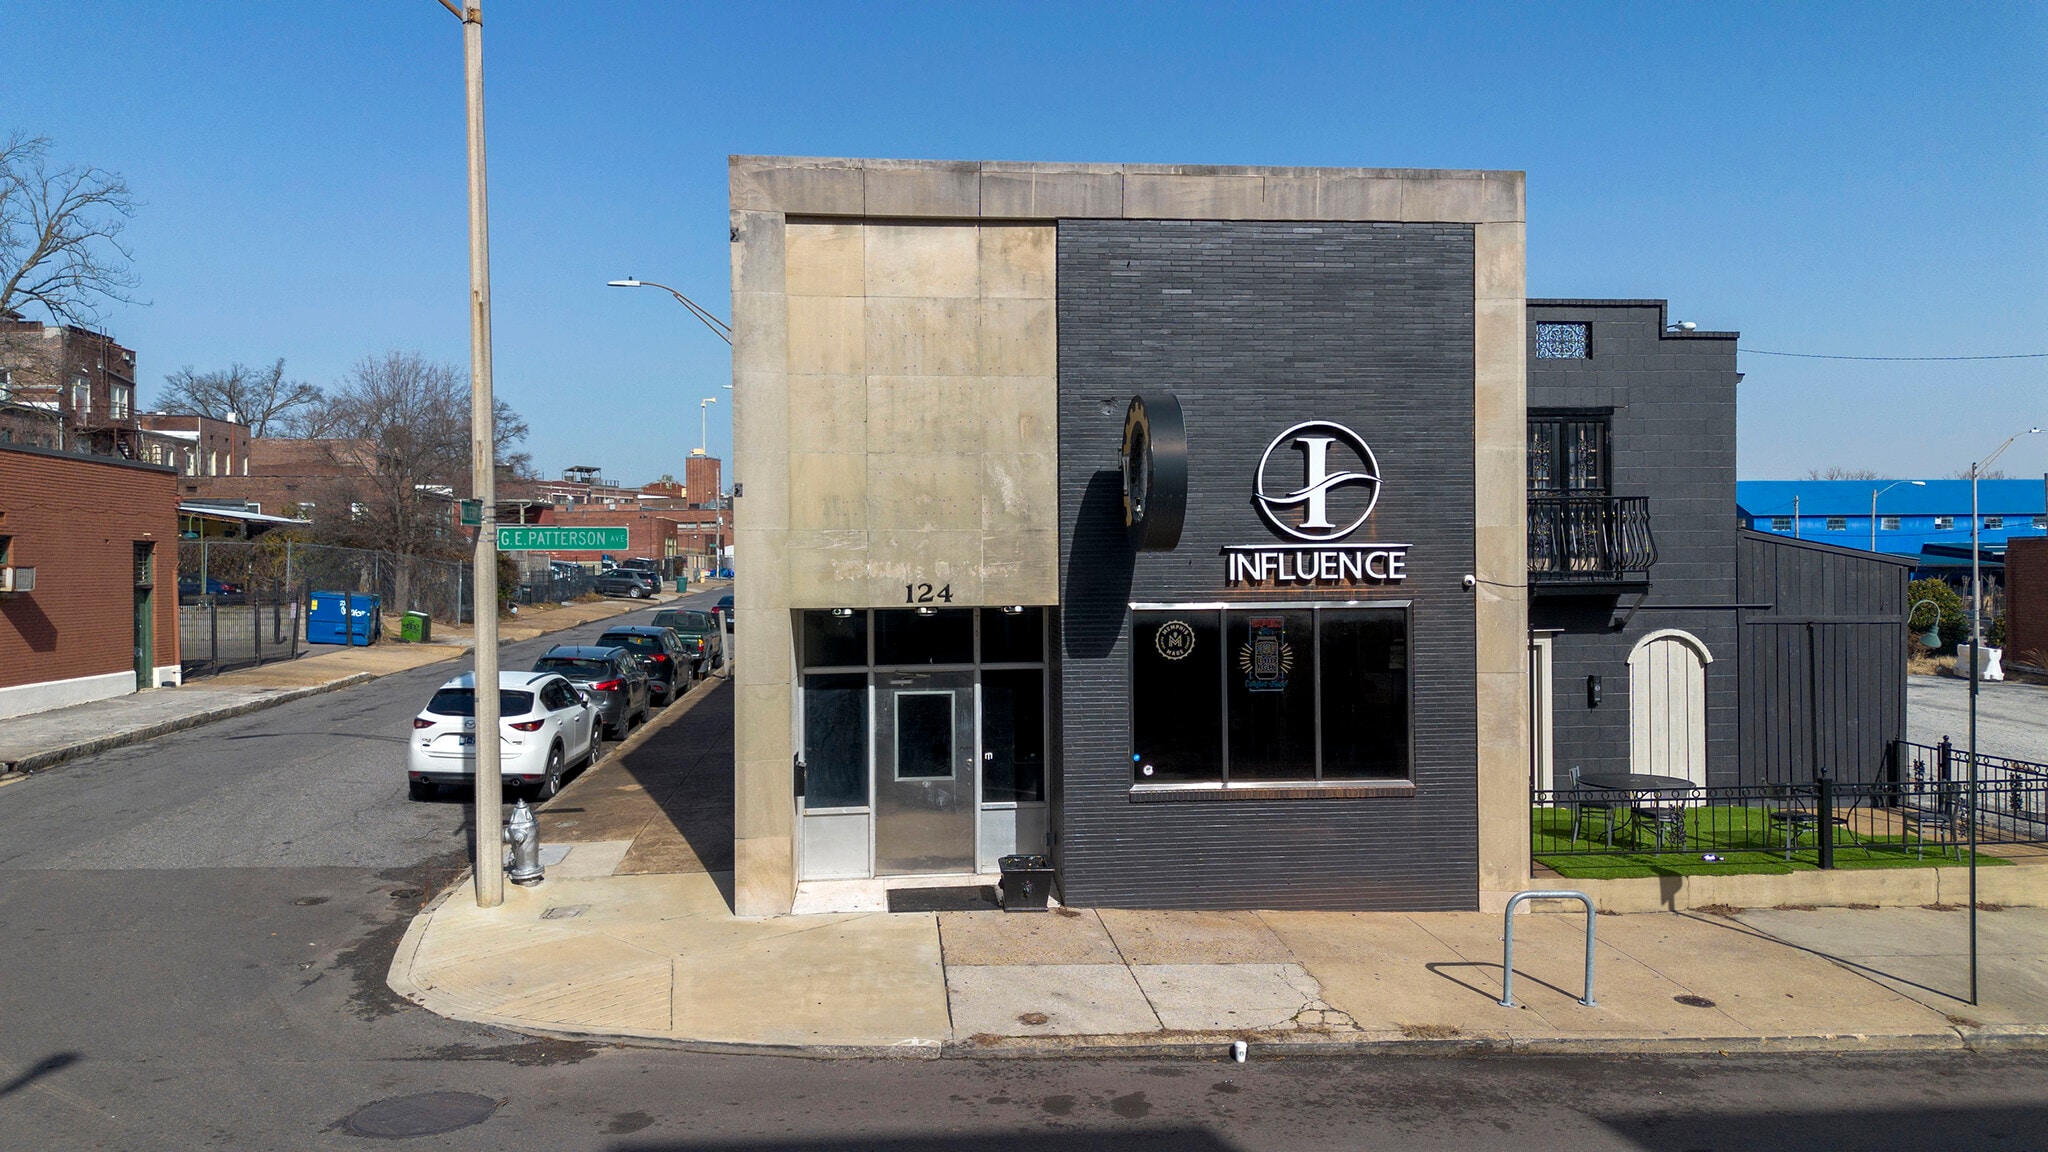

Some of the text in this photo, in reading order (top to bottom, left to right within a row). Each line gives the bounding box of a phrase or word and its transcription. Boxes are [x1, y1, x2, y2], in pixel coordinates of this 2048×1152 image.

[610, 535, 625, 543] AVE
[1229, 551, 1407, 581] INFLUENCE
[905, 583, 953, 604] 124
[1162, 624, 1189, 635] MEMPHIS
